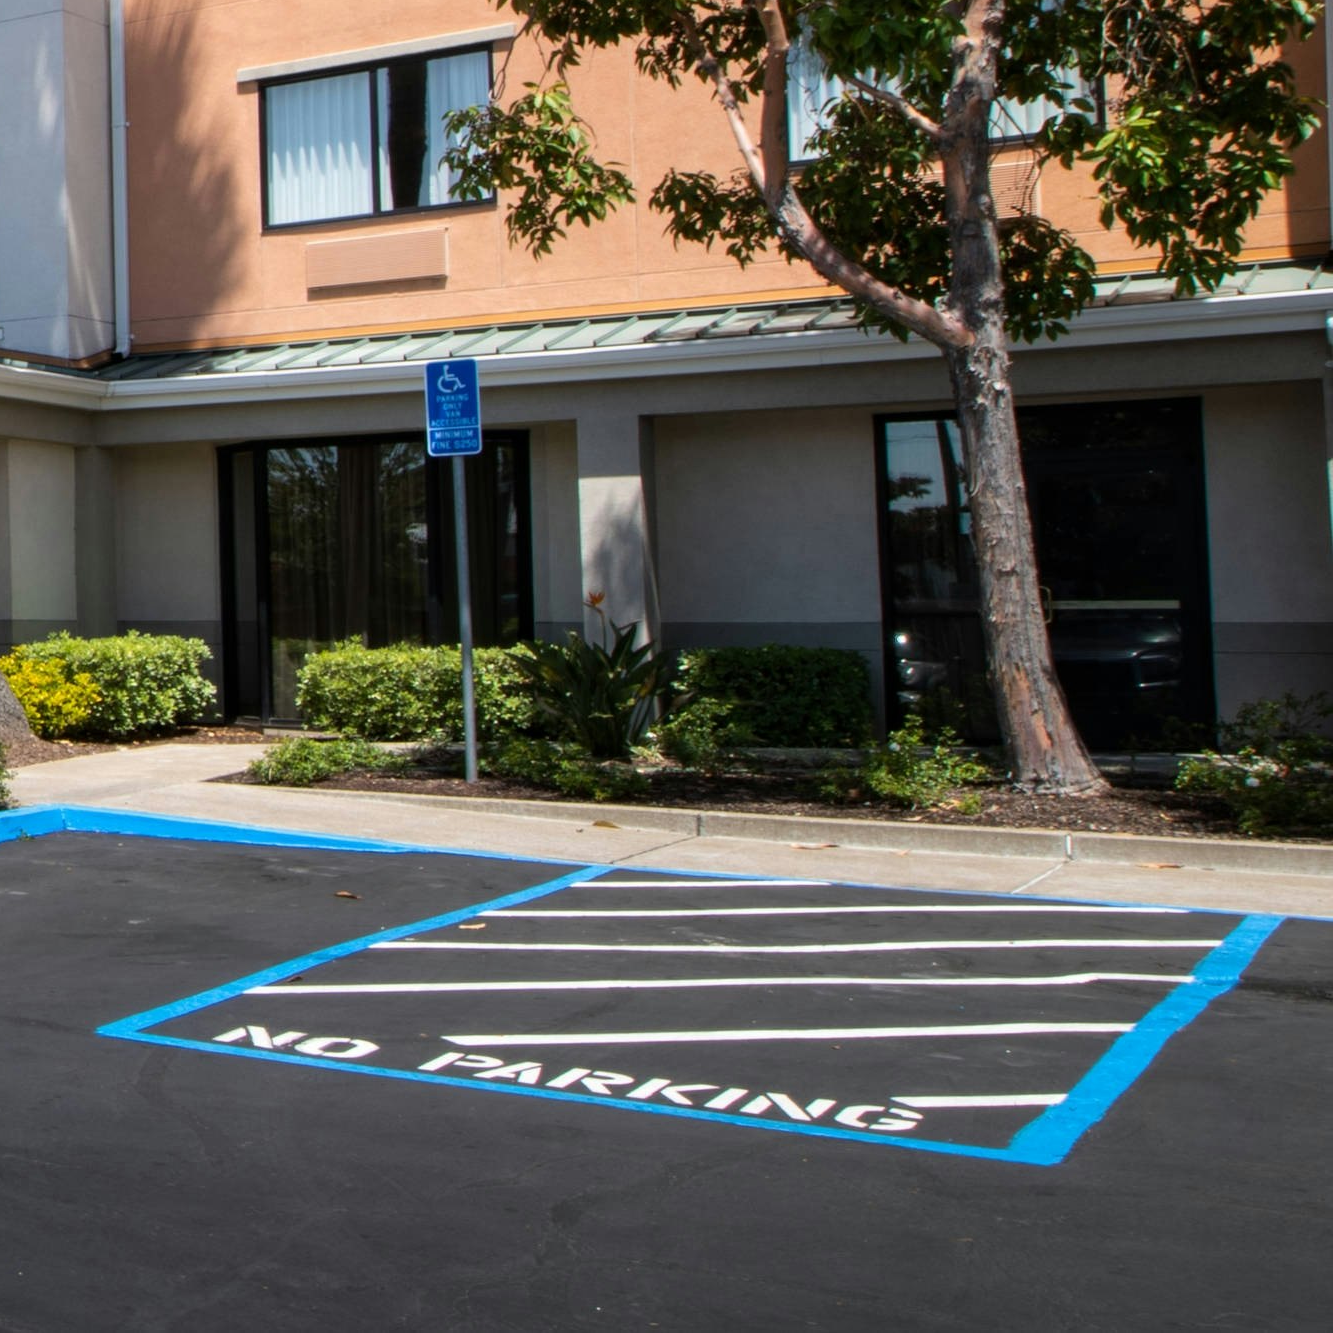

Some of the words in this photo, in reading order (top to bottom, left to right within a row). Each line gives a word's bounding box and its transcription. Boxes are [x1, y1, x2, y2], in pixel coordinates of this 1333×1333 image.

[436, 393, 469, 403] PARKING
[443, 402, 462, 411] ONLY
[445, 410, 461, 418] VAN
[431, 417, 476, 427] ACCESSIBLE
[435, 430, 474, 439] MINIMUM
[431, 441, 451, 450] FINE
[212, 1025, 381, 1060] NO
[417, 1051, 926, 1132] PARKING
